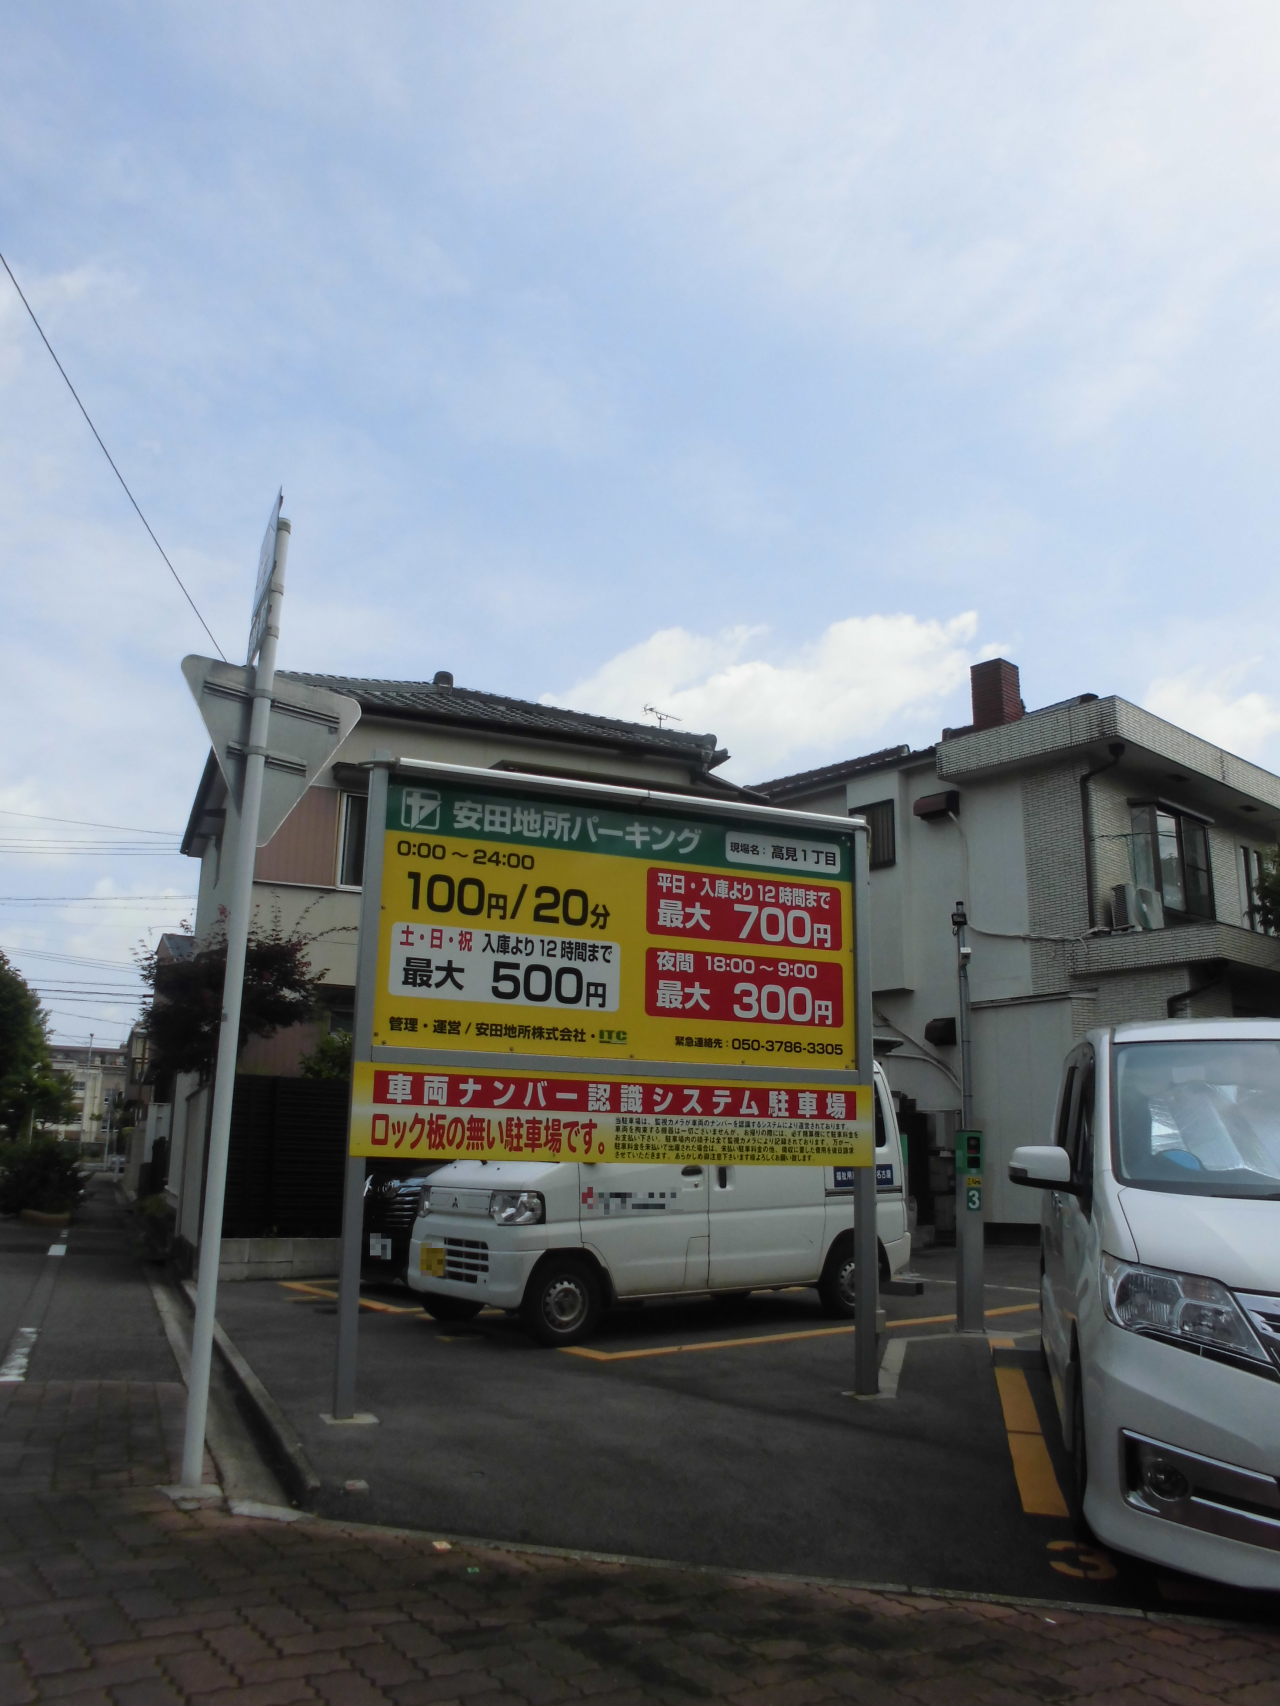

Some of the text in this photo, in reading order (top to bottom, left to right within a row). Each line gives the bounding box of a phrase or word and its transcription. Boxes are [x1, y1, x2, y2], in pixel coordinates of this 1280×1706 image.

[452, 800, 702, 854] 安田地所パーキング
[407, 871, 611, 930] 100円/20分
[657, 900, 831, 948] 最大 700円
[402, 957, 607, 1008] 最大 500円
[657, 951, 694, 973] 夜間
[656, 980, 833, 1025] 最大 300円
[386, 1073, 847, 1119] 車両ナンバー認識システム駐車場
[371, 1112, 605, 1155] ロック板の無い駐車場です。
[968, 1190, 980, 1209] 3
[1046, 1540, 1118, 1579] 3
